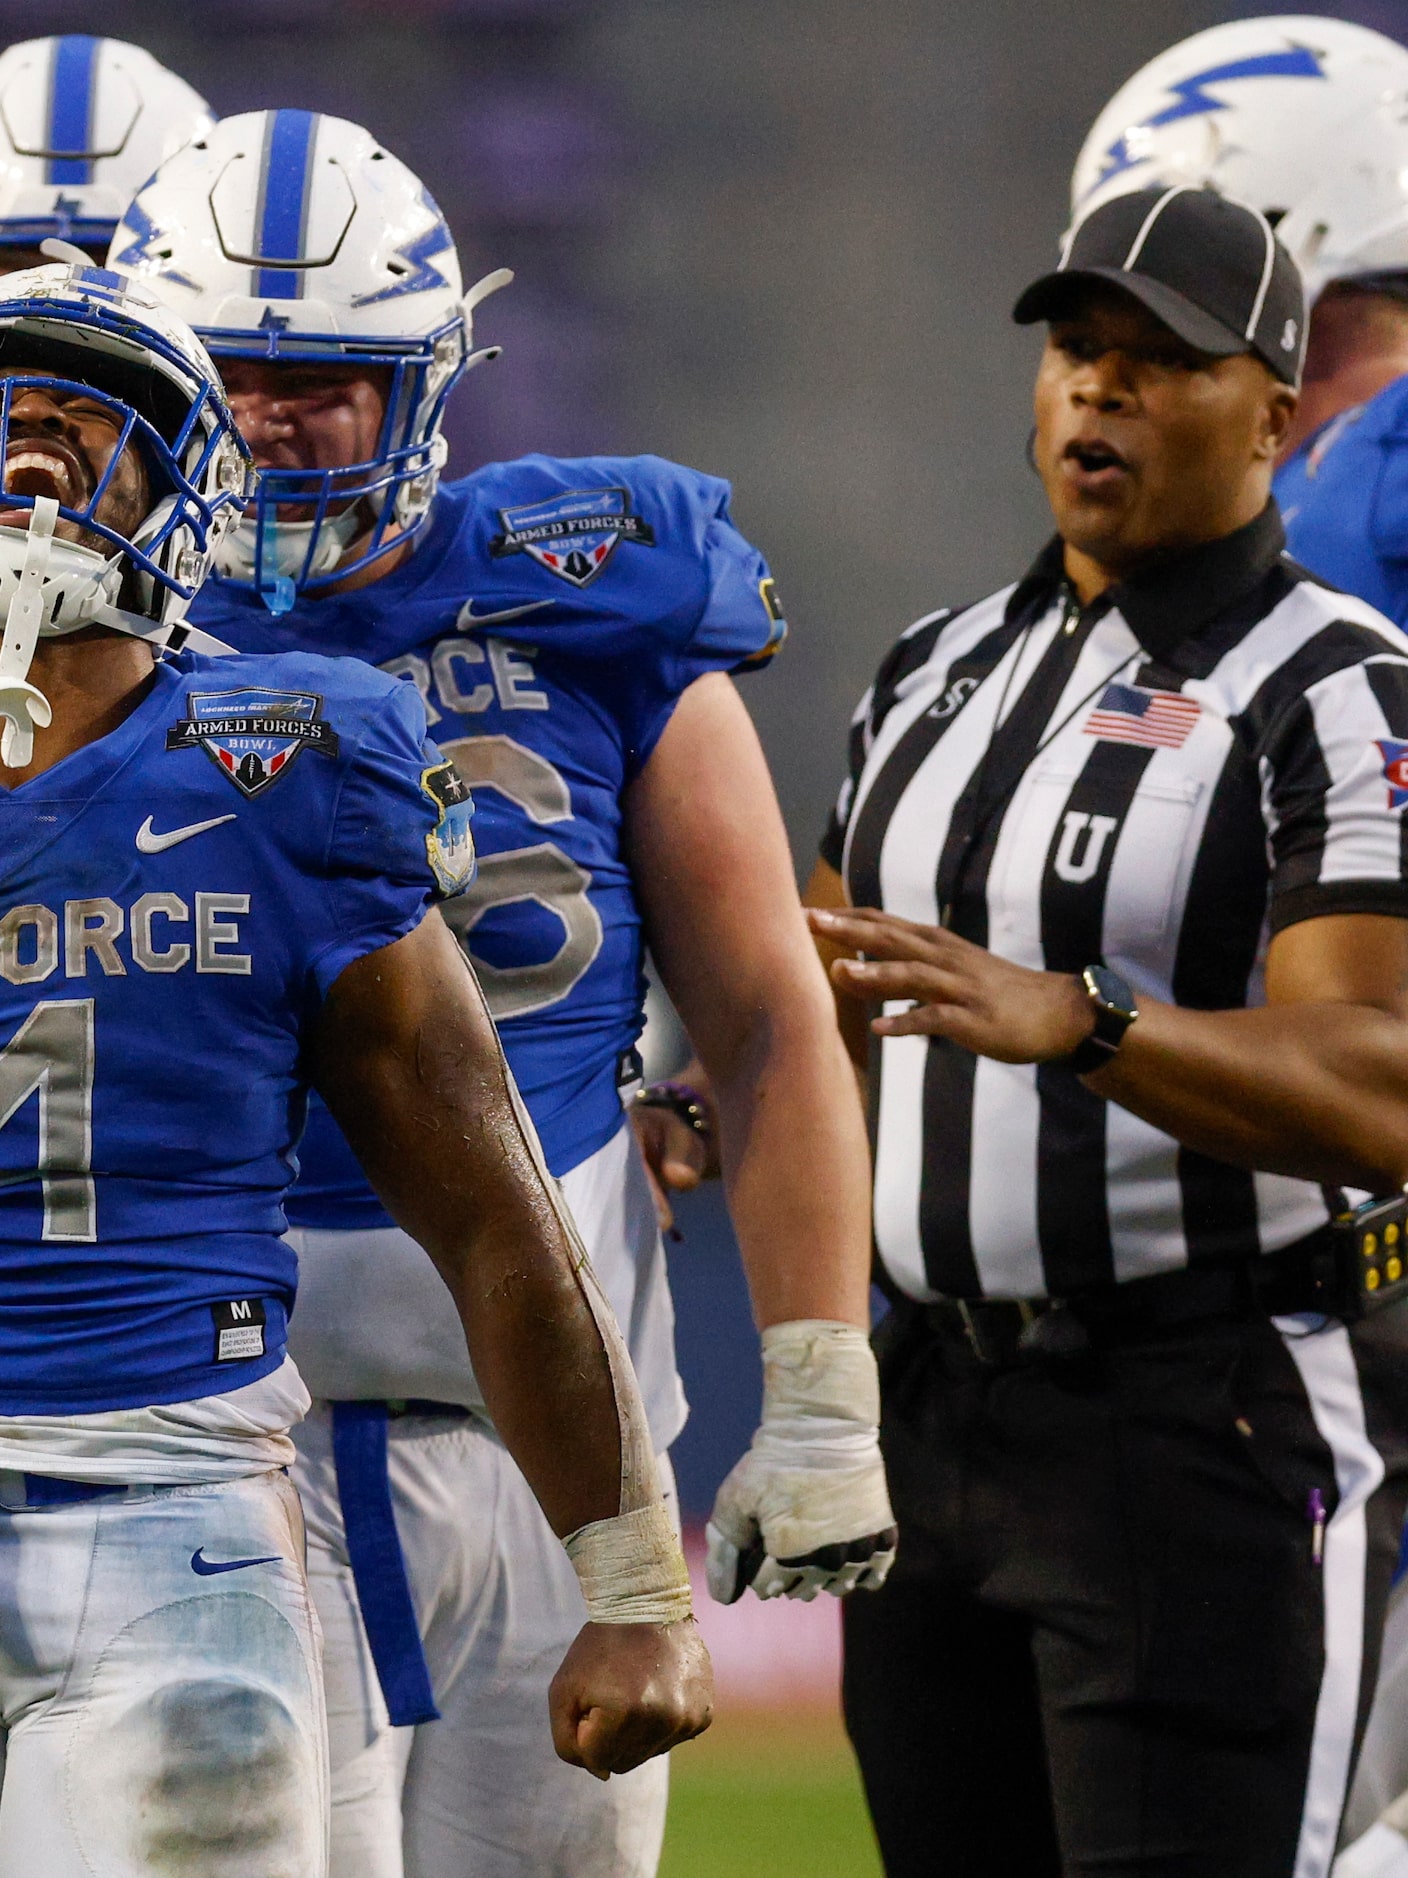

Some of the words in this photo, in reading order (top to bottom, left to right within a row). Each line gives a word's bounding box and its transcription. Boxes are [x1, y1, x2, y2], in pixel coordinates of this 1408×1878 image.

[504, 523, 564, 545] ARMED
[567, 517, 637, 532] FORCES
[377, 638, 550, 726] RCE
[185, 718, 247, 736] ARMED
[253, 718, 322, 739] FORCES
[228, 738, 277, 751] BOWL
[1054, 810, 1117, 884] U
[230, 1300, 252, 1321] M
